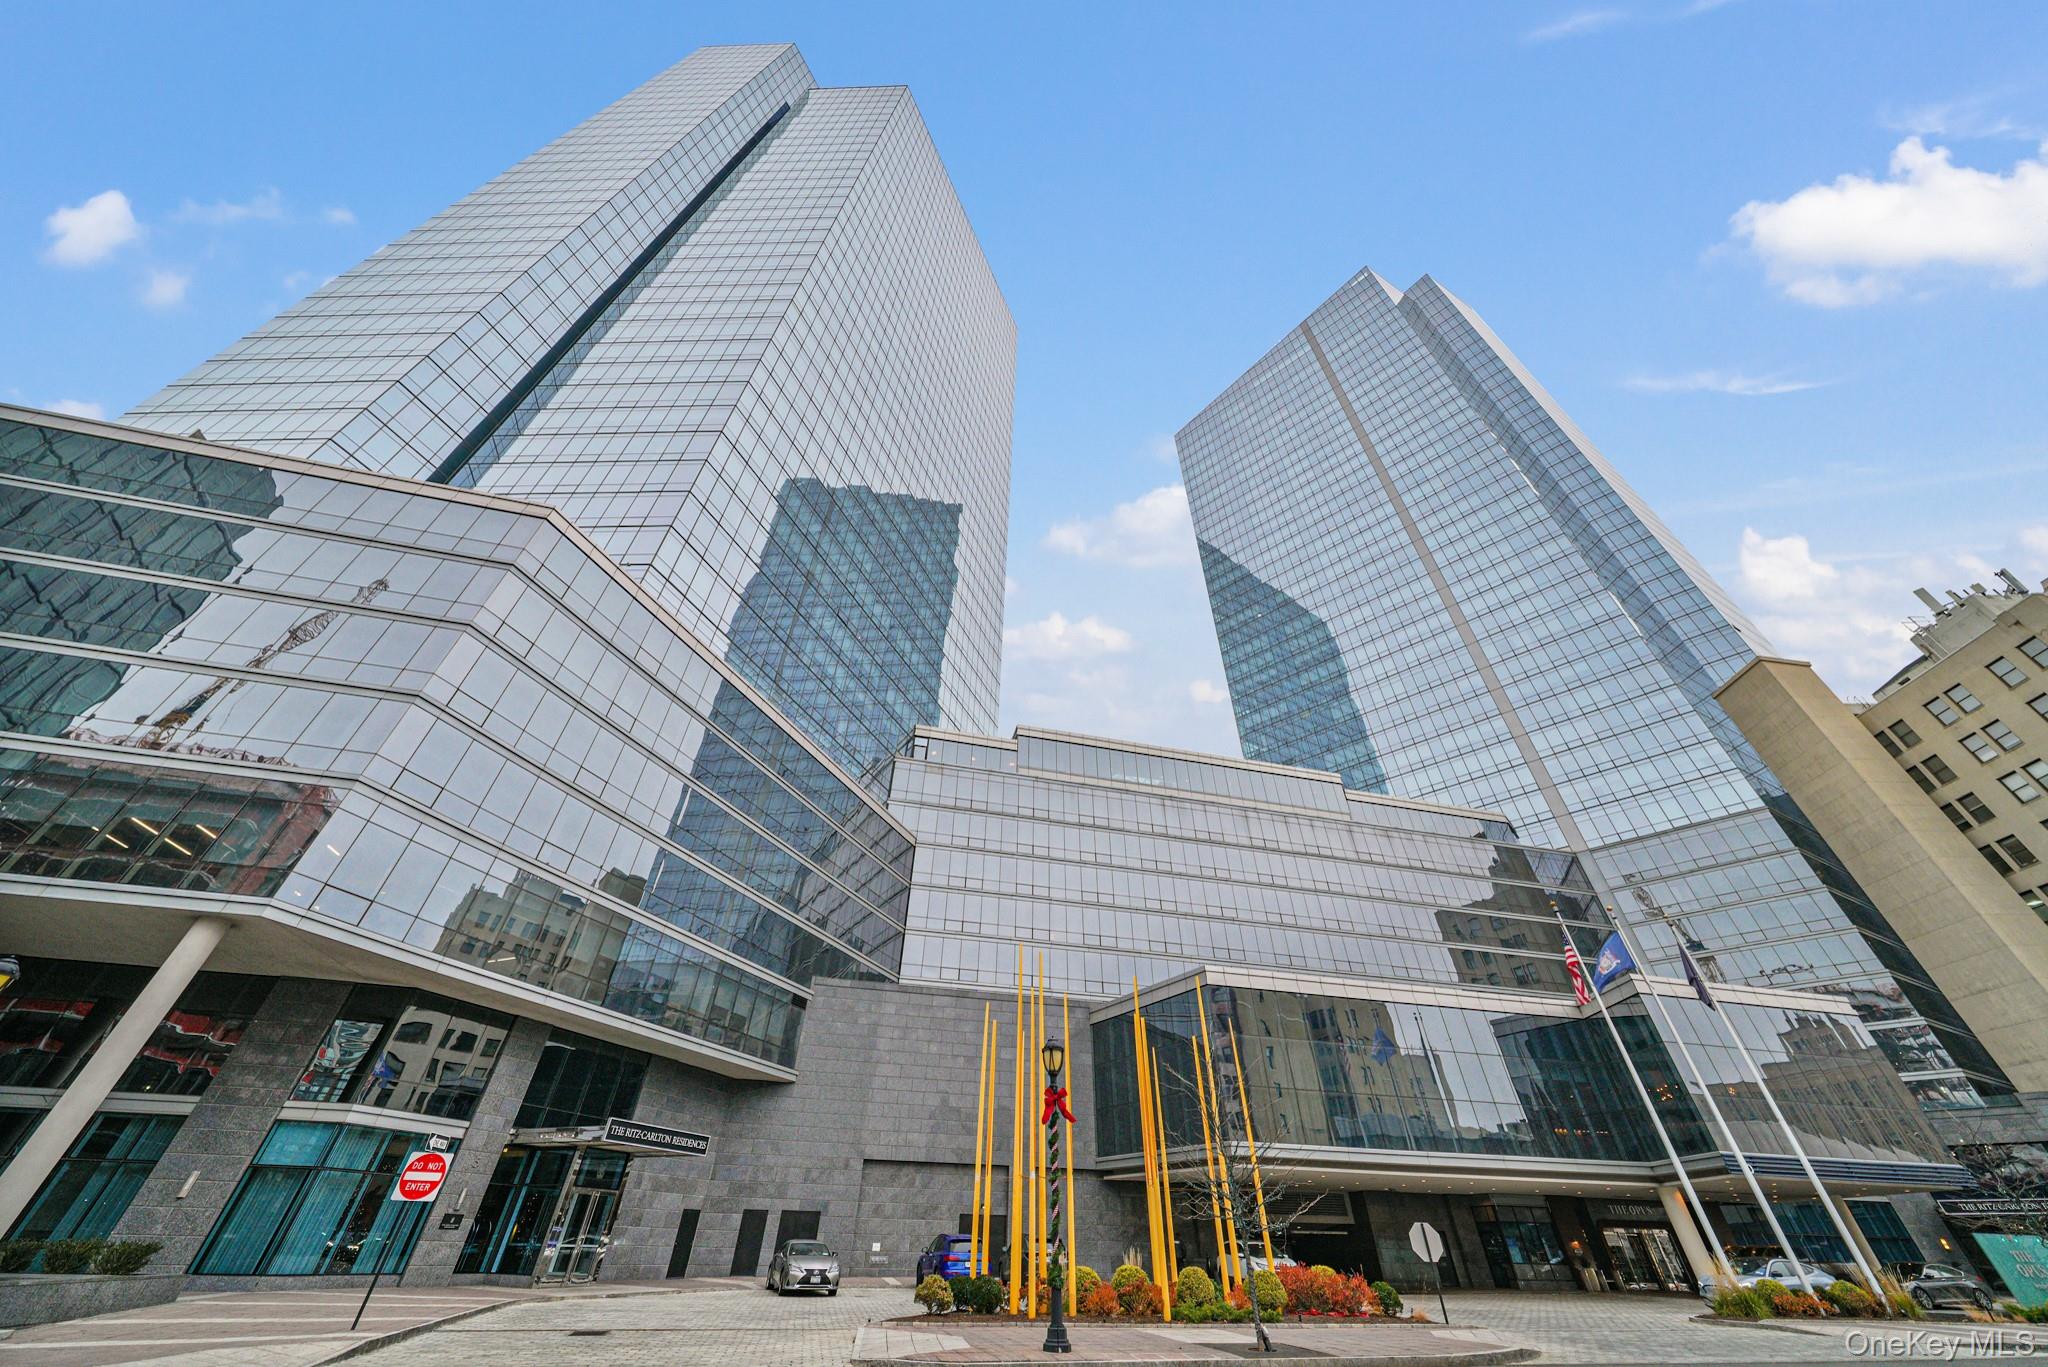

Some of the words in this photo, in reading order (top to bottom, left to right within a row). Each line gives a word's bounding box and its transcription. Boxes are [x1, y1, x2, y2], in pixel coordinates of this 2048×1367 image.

[611, 1125, 625, 1136] THE
[625, 1127, 672, 1145] RITZ-CARLTON
[672, 1136, 707, 1150] RESIDENCES
[412, 1162, 424, 1170] DO
[427, 1162, 443, 1170] NOT
[405, 1182, 431, 1191] ENTER
[1958, 1203, 1977, 1211] THE
